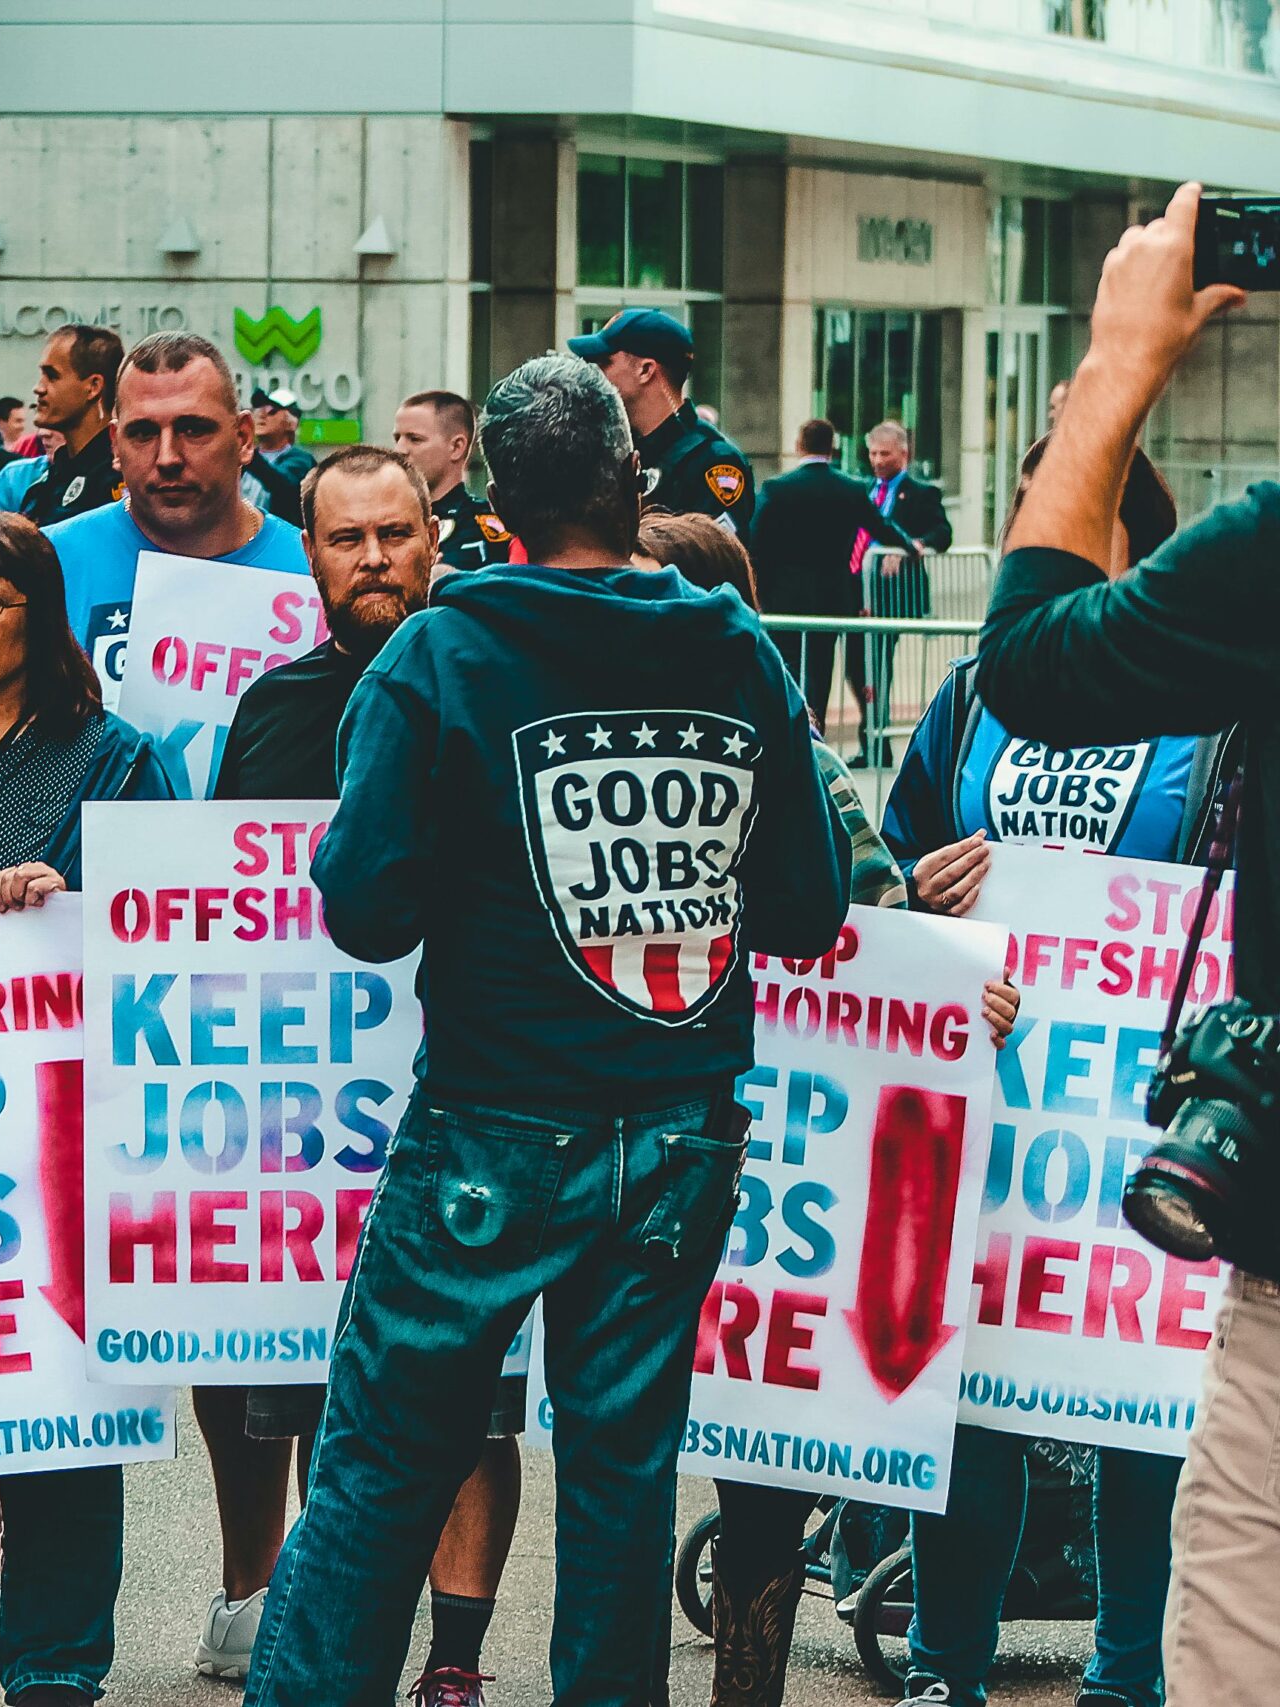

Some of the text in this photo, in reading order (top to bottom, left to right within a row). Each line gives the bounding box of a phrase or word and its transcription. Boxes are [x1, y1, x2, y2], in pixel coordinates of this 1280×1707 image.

[1010, 740, 1137, 773] GOOD
[551, 769, 740, 832] GOOD
[997, 773, 1123, 815] JOBS
[999, 810, 1109, 847] NATION
[567, 837, 729, 901] JOBS
[109, 886, 332, 943] OFFSH
[578, 893, 732, 940] NATION
[111, 970, 393, 1067] KEEP
[104, 1077, 396, 1176] JOBS
